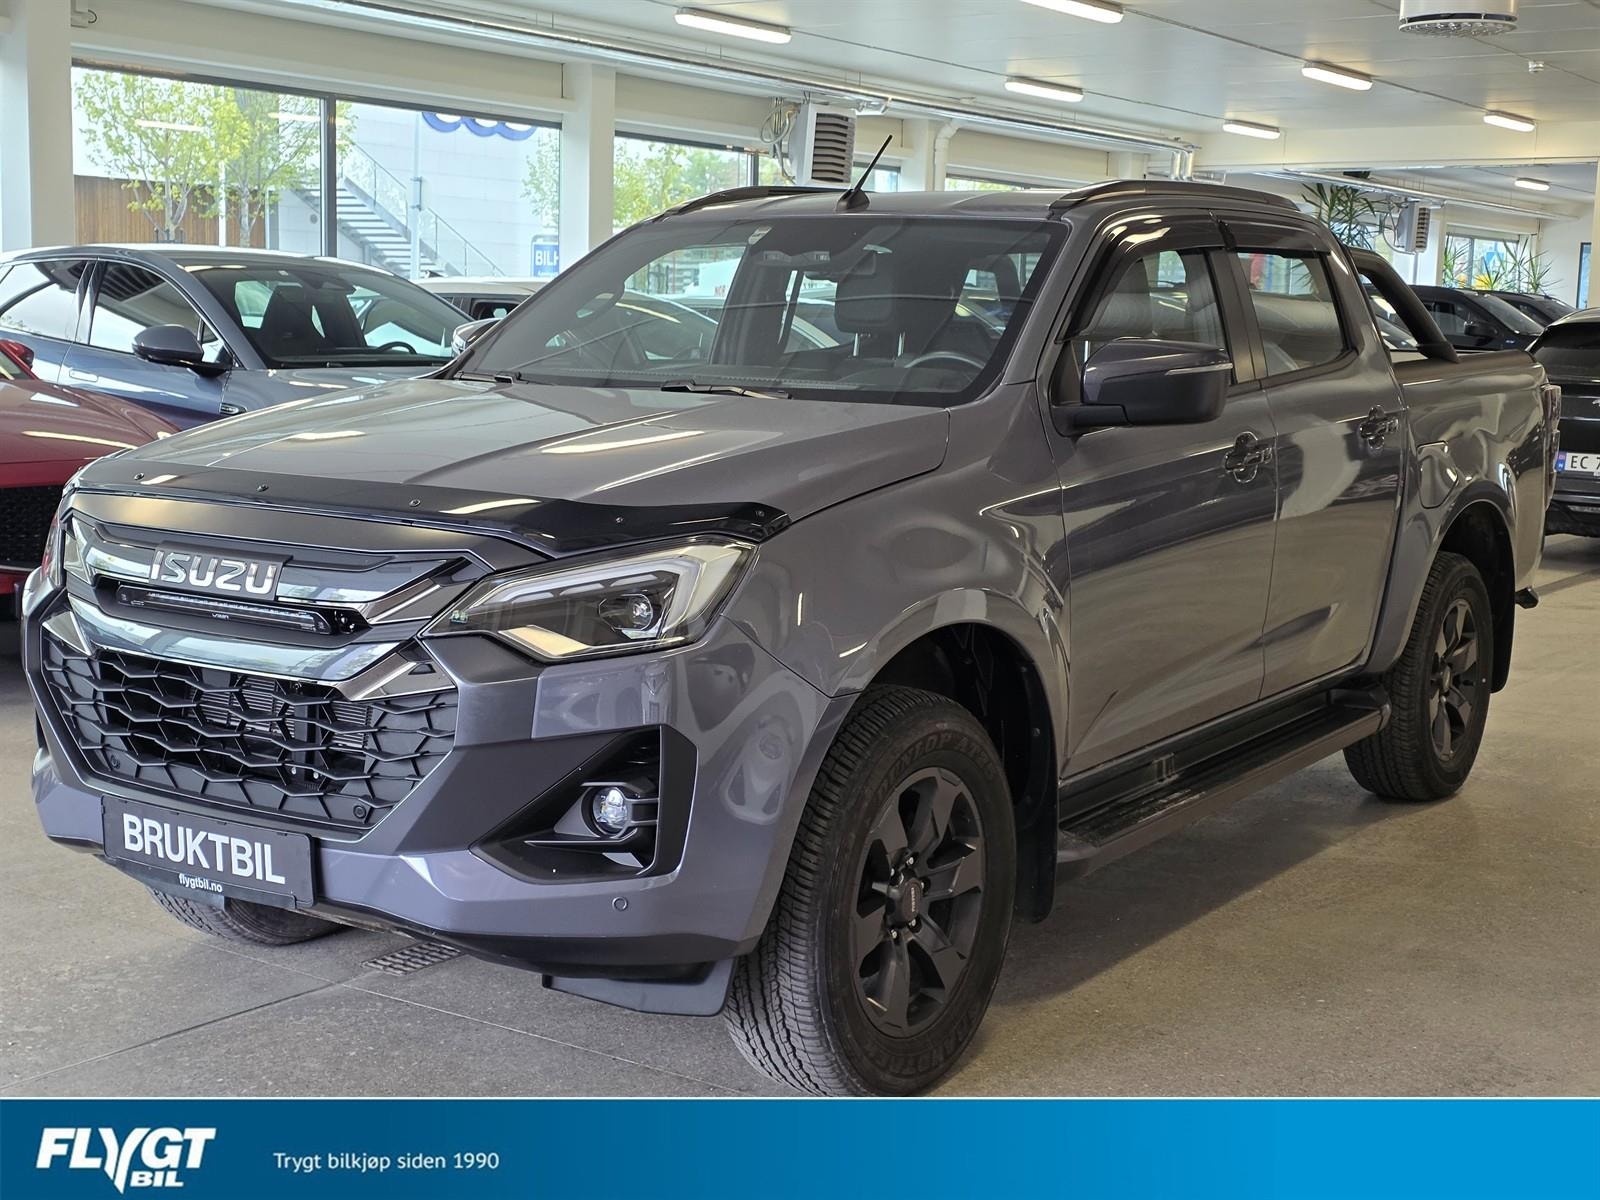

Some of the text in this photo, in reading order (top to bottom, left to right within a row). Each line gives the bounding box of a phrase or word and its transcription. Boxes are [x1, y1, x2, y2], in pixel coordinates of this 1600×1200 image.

[1571, 455, 1589, 470] EC
[150, 550, 277, 595] ISUZU
[123, 813, 286, 884] BRUKTBIL
[178, 873, 223, 893] flygtbil.no
